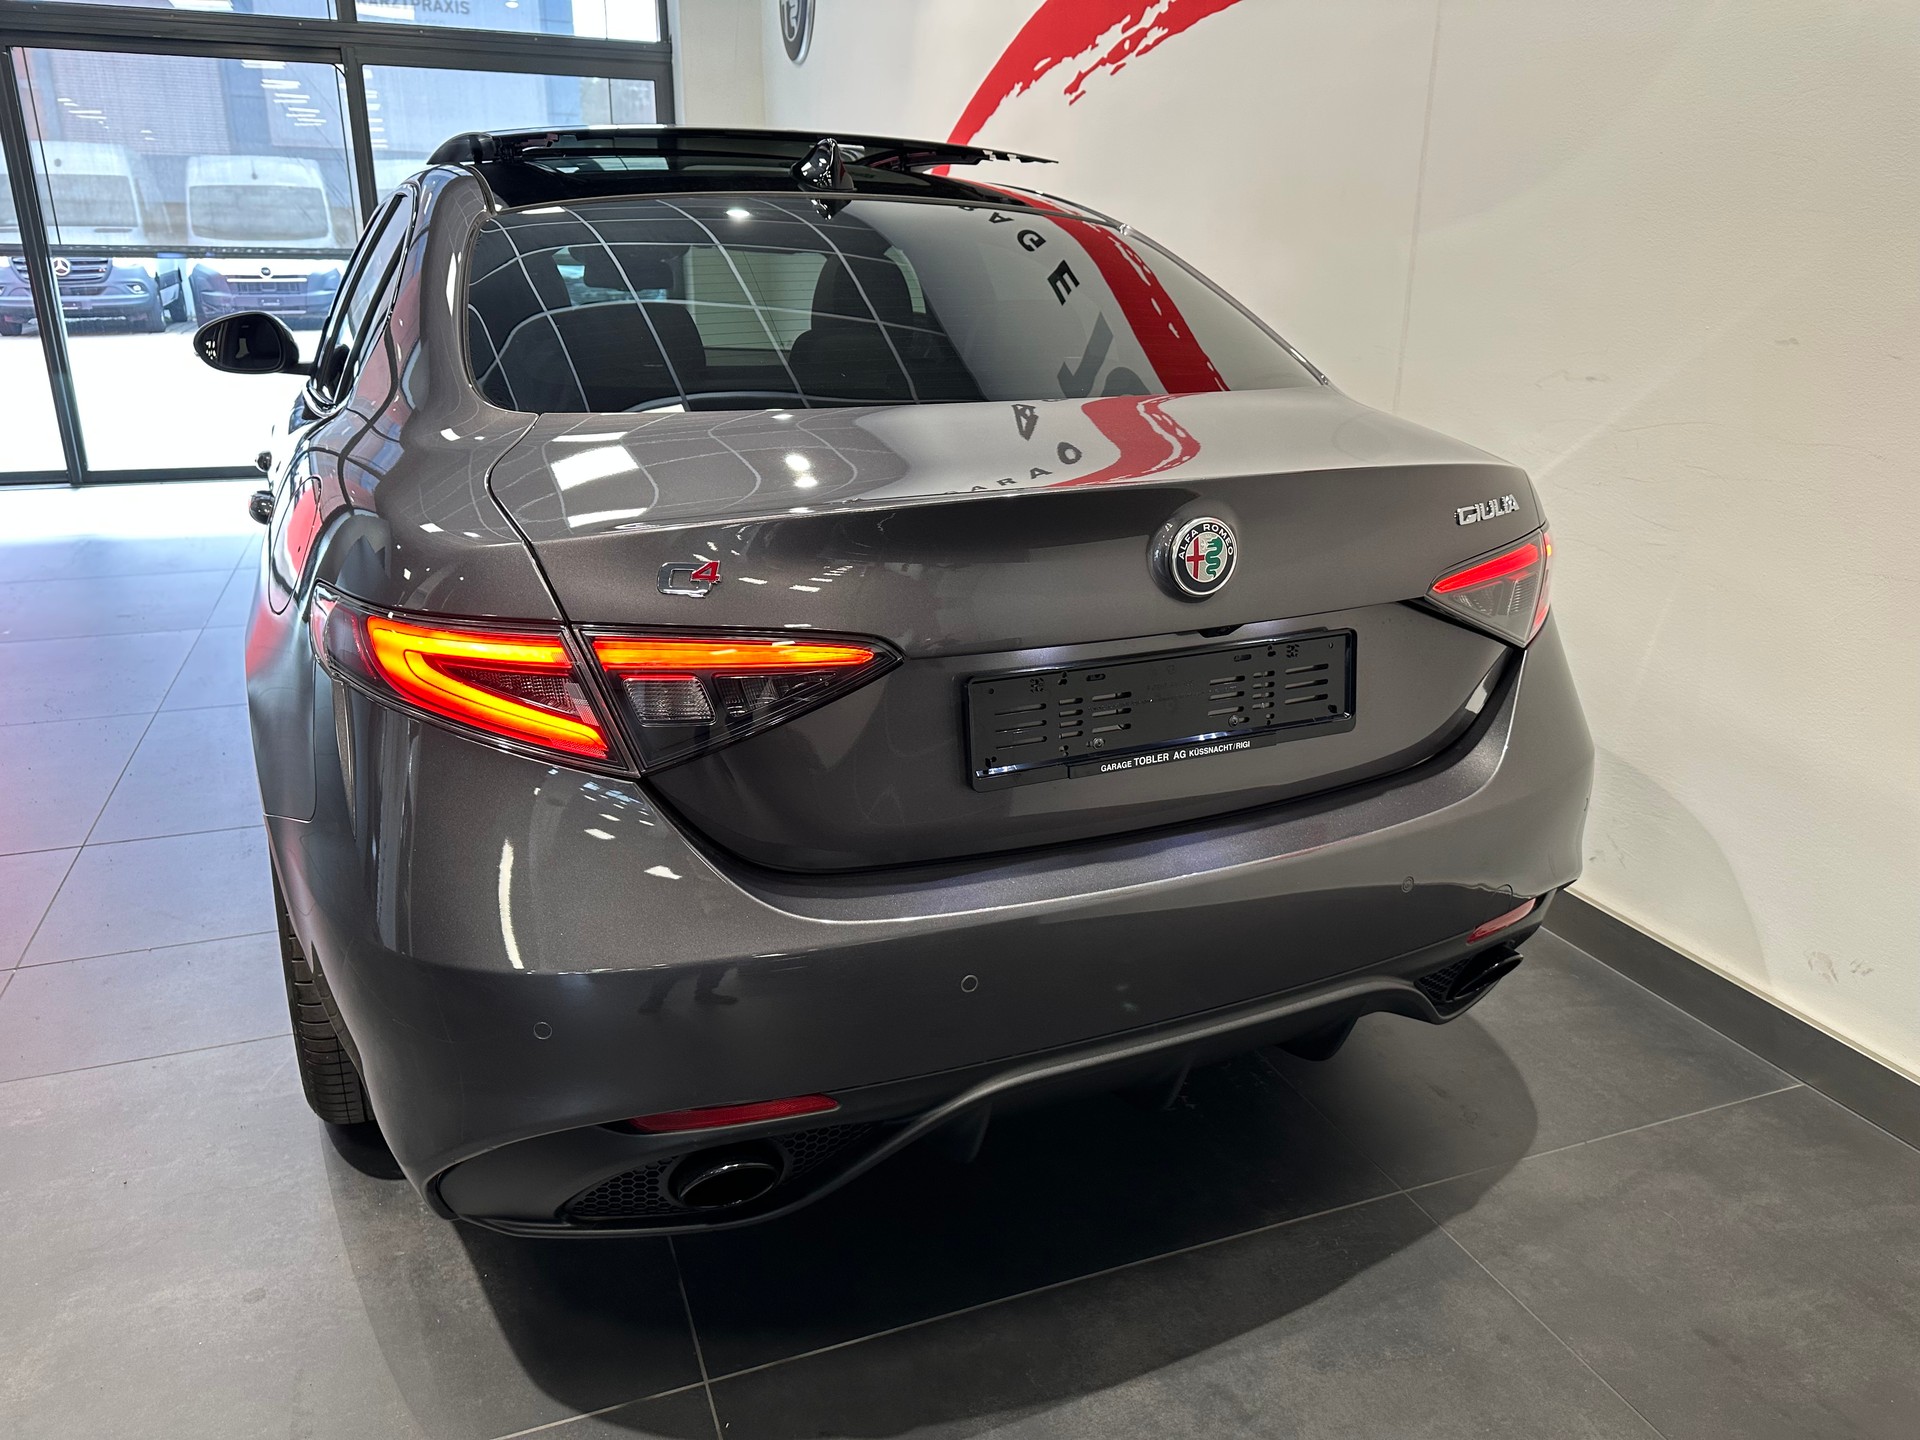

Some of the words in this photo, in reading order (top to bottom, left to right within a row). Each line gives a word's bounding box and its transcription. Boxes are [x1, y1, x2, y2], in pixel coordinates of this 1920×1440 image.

[1455, 493, 1520, 526] GIULIA
[1178, 529, 1199, 560] ALFA
[1202, 523, 1234, 556] ROMEO
[1100, 760, 1133, 773] GARAGE
[1133, 752, 1170, 767] TOBLER
[1173, 749, 1187, 760] AG
[1188, 740, 1251, 757] KÜSSNACHT/RIGI
